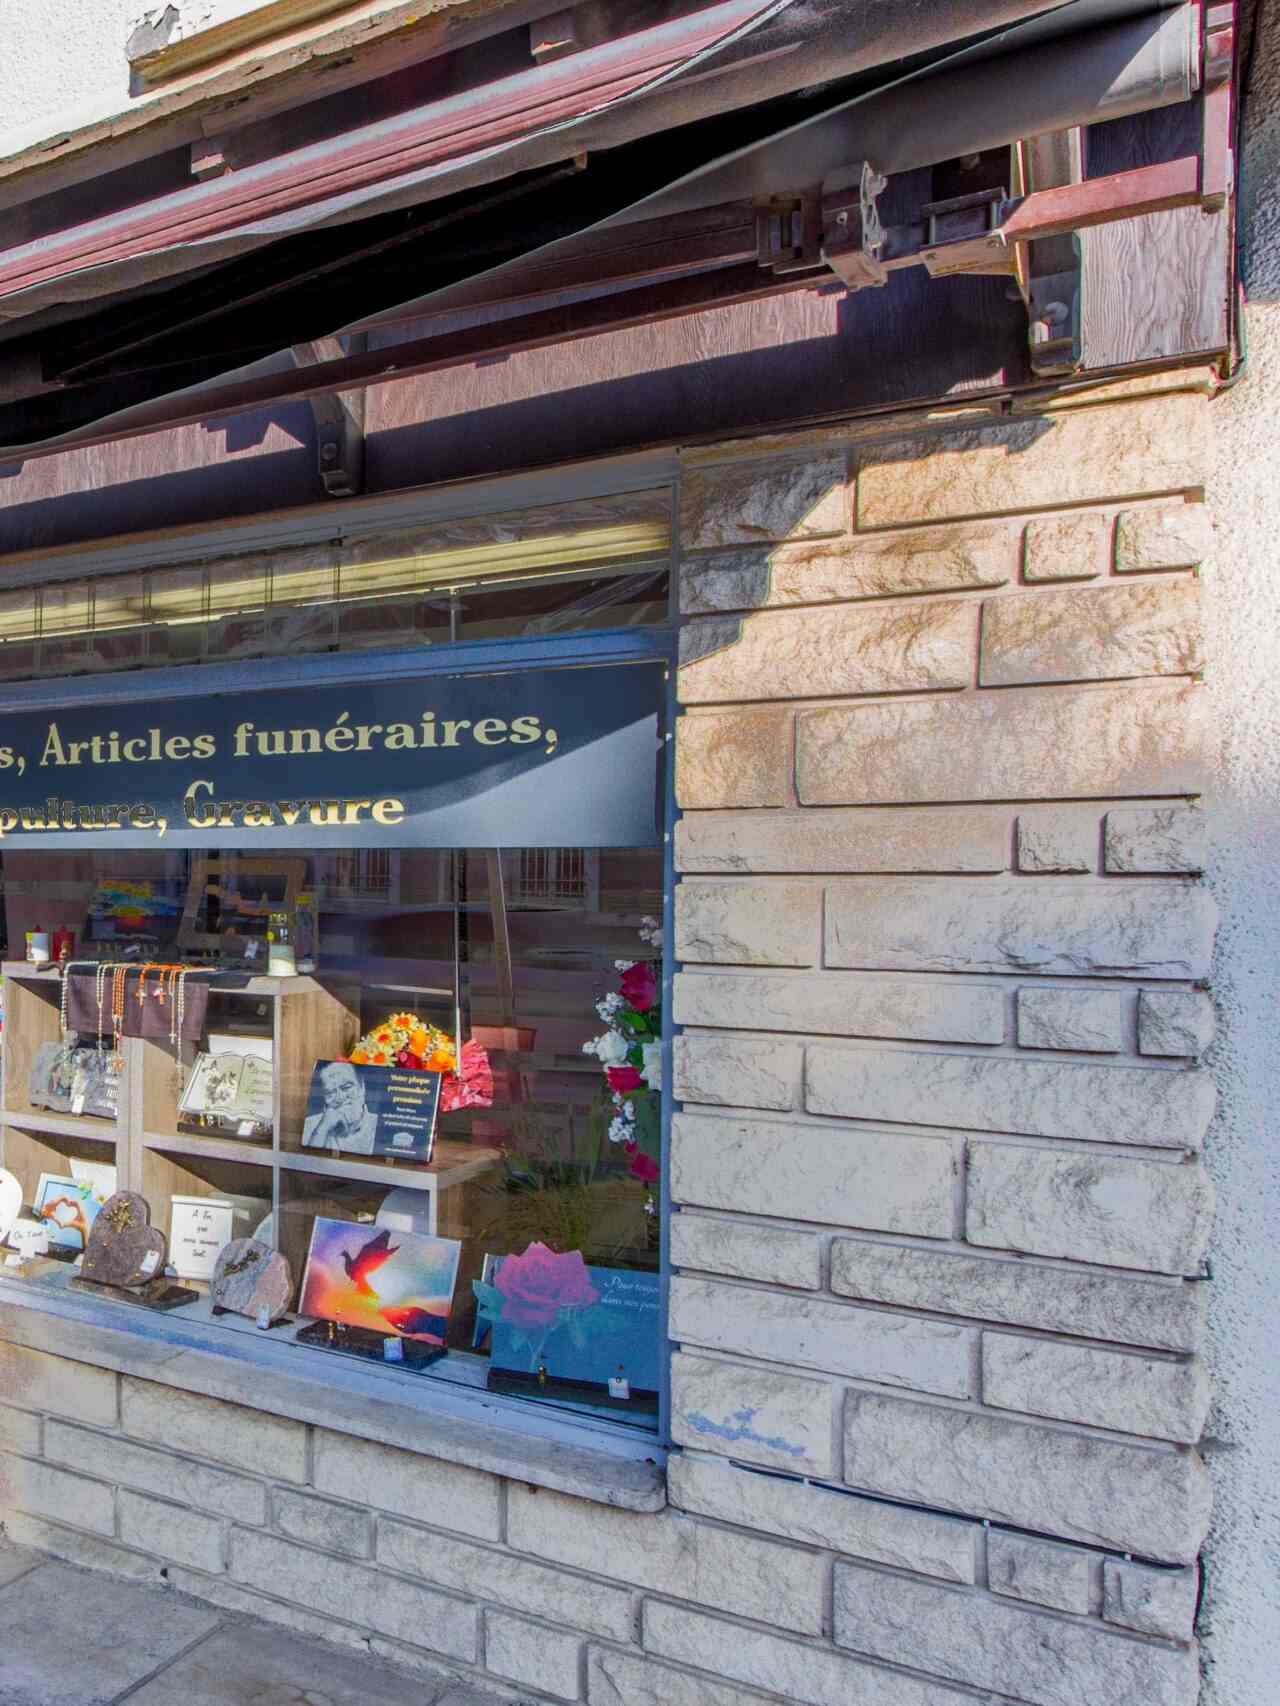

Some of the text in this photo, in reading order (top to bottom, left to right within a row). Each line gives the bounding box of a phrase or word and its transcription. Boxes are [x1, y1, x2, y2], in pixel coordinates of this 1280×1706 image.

[39, 721, 216, 767] Articles
[233, 710, 558, 757] funéraires,
[183, 780, 406, 827] Gravure
